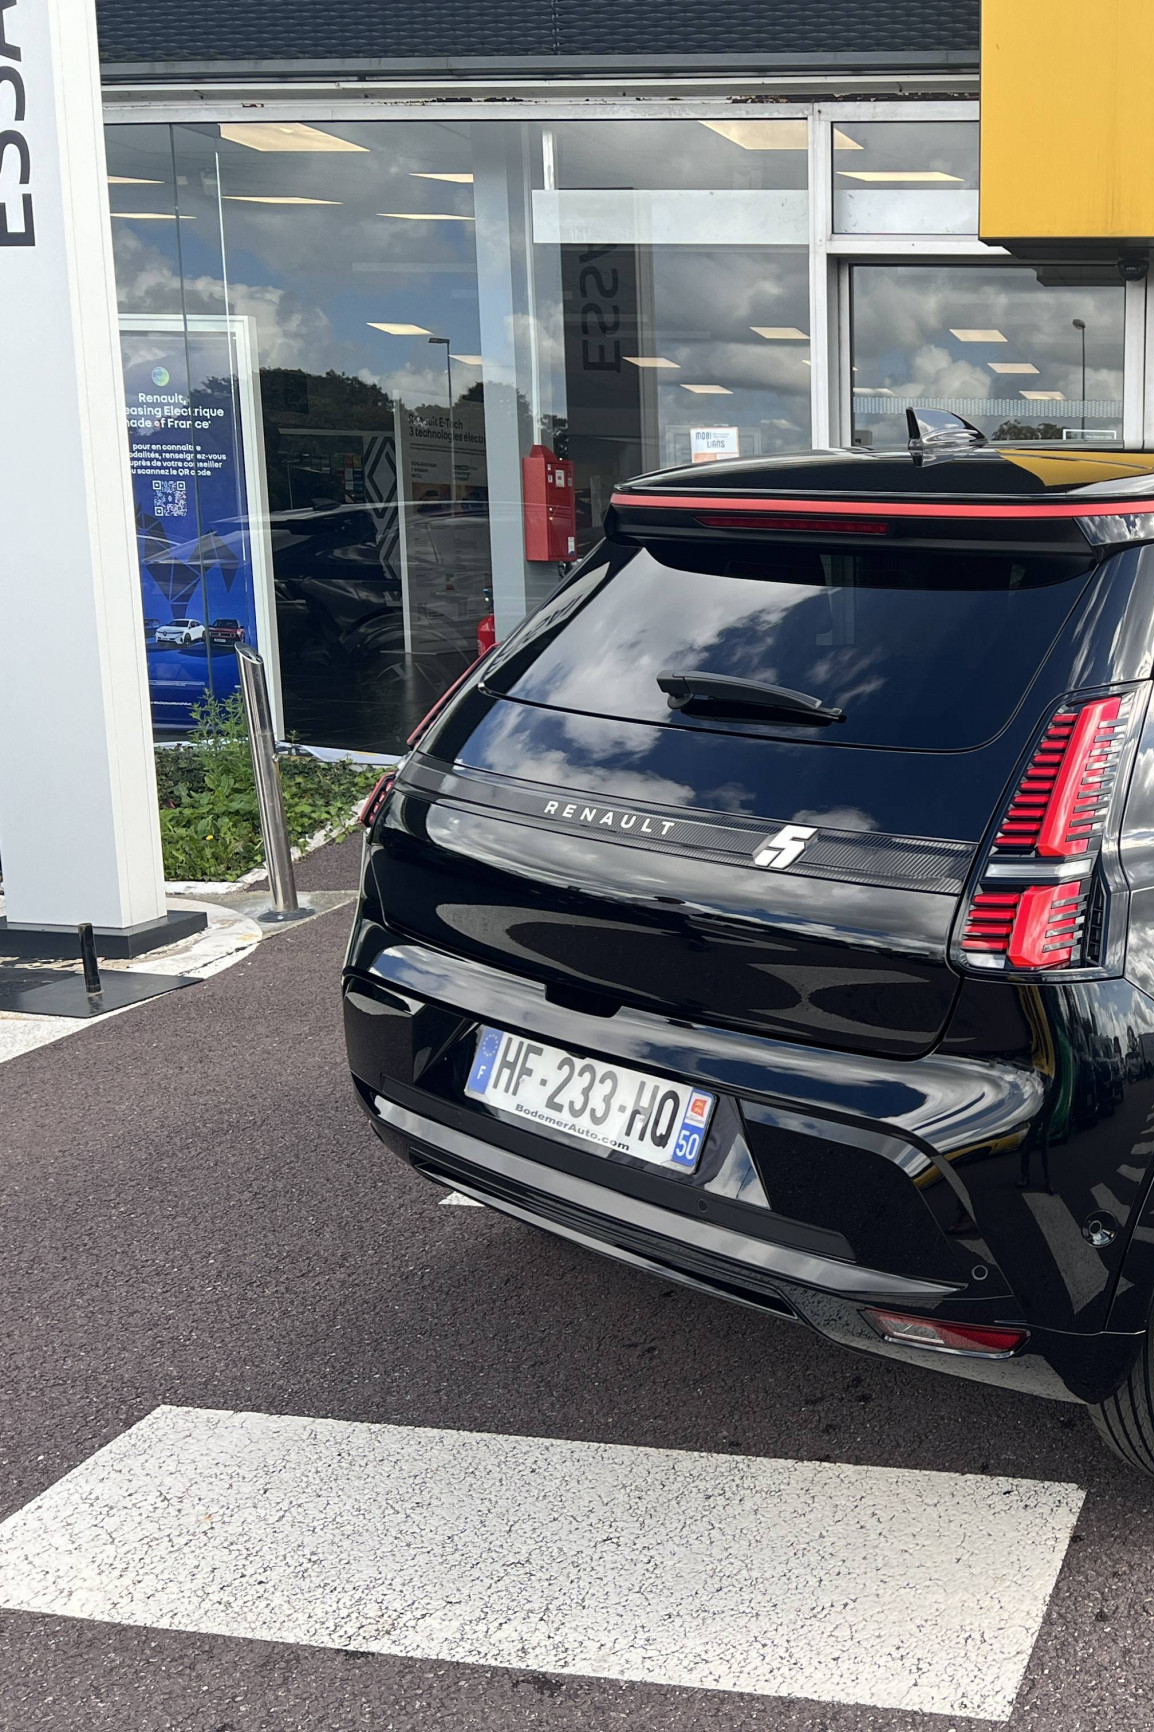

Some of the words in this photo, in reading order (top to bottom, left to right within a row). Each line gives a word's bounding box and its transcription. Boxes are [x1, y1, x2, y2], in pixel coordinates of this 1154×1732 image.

[138, 393, 187, 406] Renault,
[125, 405, 162, 417] easing
[154, 418, 166, 429] of
[409, 426, 414, 436] 3
[132, 443, 151, 452] pour
[128, 451, 161, 460] odalités,
[129, 459, 151, 468] uprès
[151, 460, 161, 468] de
[178, 468, 190, 477] QR
[543, 800, 676, 836] RENAULT
[753, 824, 819, 870] 5
[475, 1064, 487, 1080] F
[492, 1036, 681, 1150] HF-233-HQ
[515, 1103, 630, 1152] BodemerAuto.com
[674, 1130, 700, 1160] 50
